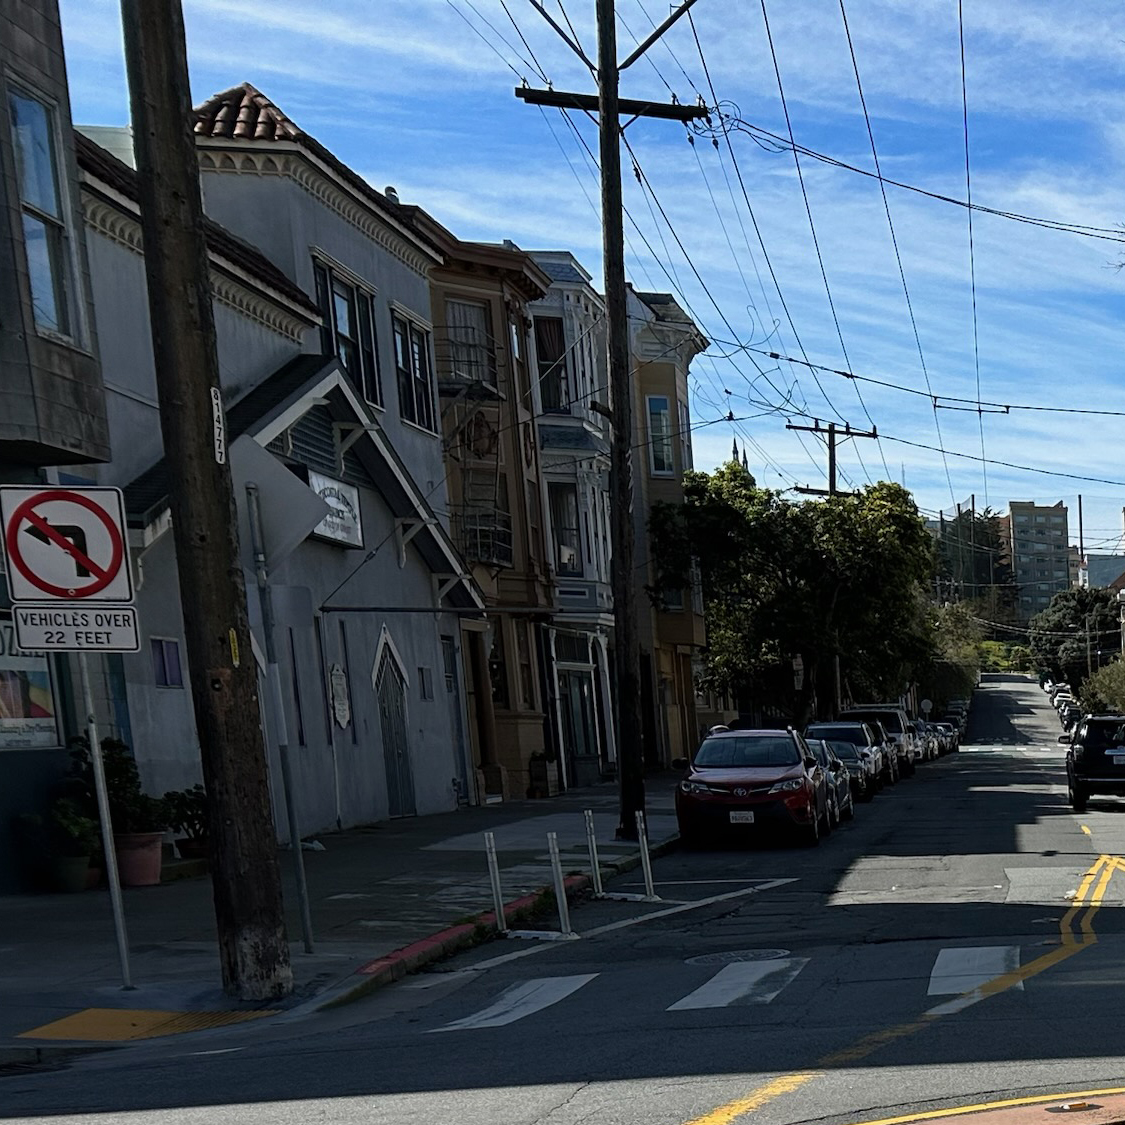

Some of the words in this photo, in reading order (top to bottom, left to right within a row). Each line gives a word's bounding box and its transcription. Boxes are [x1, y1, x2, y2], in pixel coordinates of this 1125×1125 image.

[213, 389, 223, 462] 814777
[20, 612, 89, 627] VEHICLES
[94, 614, 132, 628] OVER
[44, 631, 67, 643] 22
[75, 632, 113, 645] FEET
